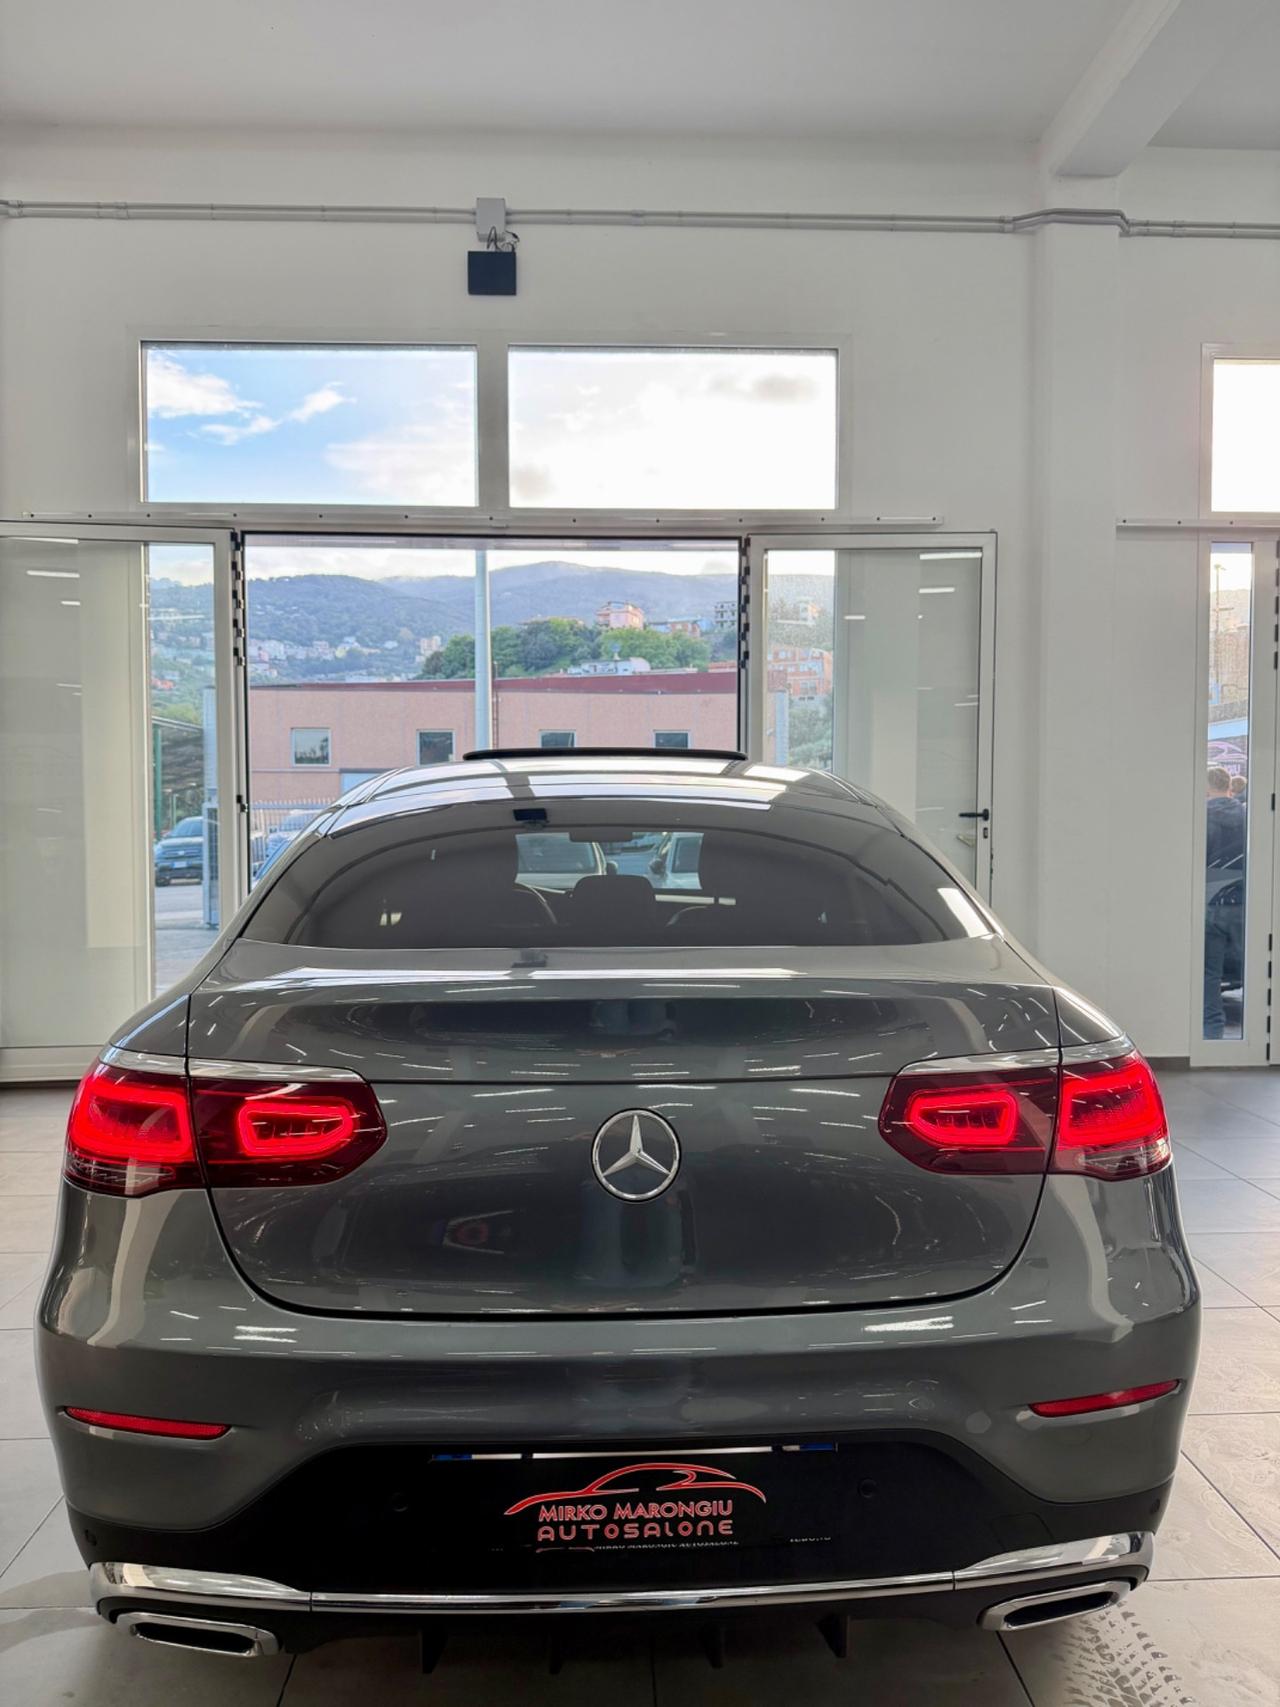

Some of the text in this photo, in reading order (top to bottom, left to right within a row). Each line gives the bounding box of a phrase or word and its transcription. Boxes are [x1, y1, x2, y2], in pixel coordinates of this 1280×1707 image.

[538, 1499, 734, 1522] MIRKO MARONGIU
[536, 1519, 734, 1541] AUTOSALONE
